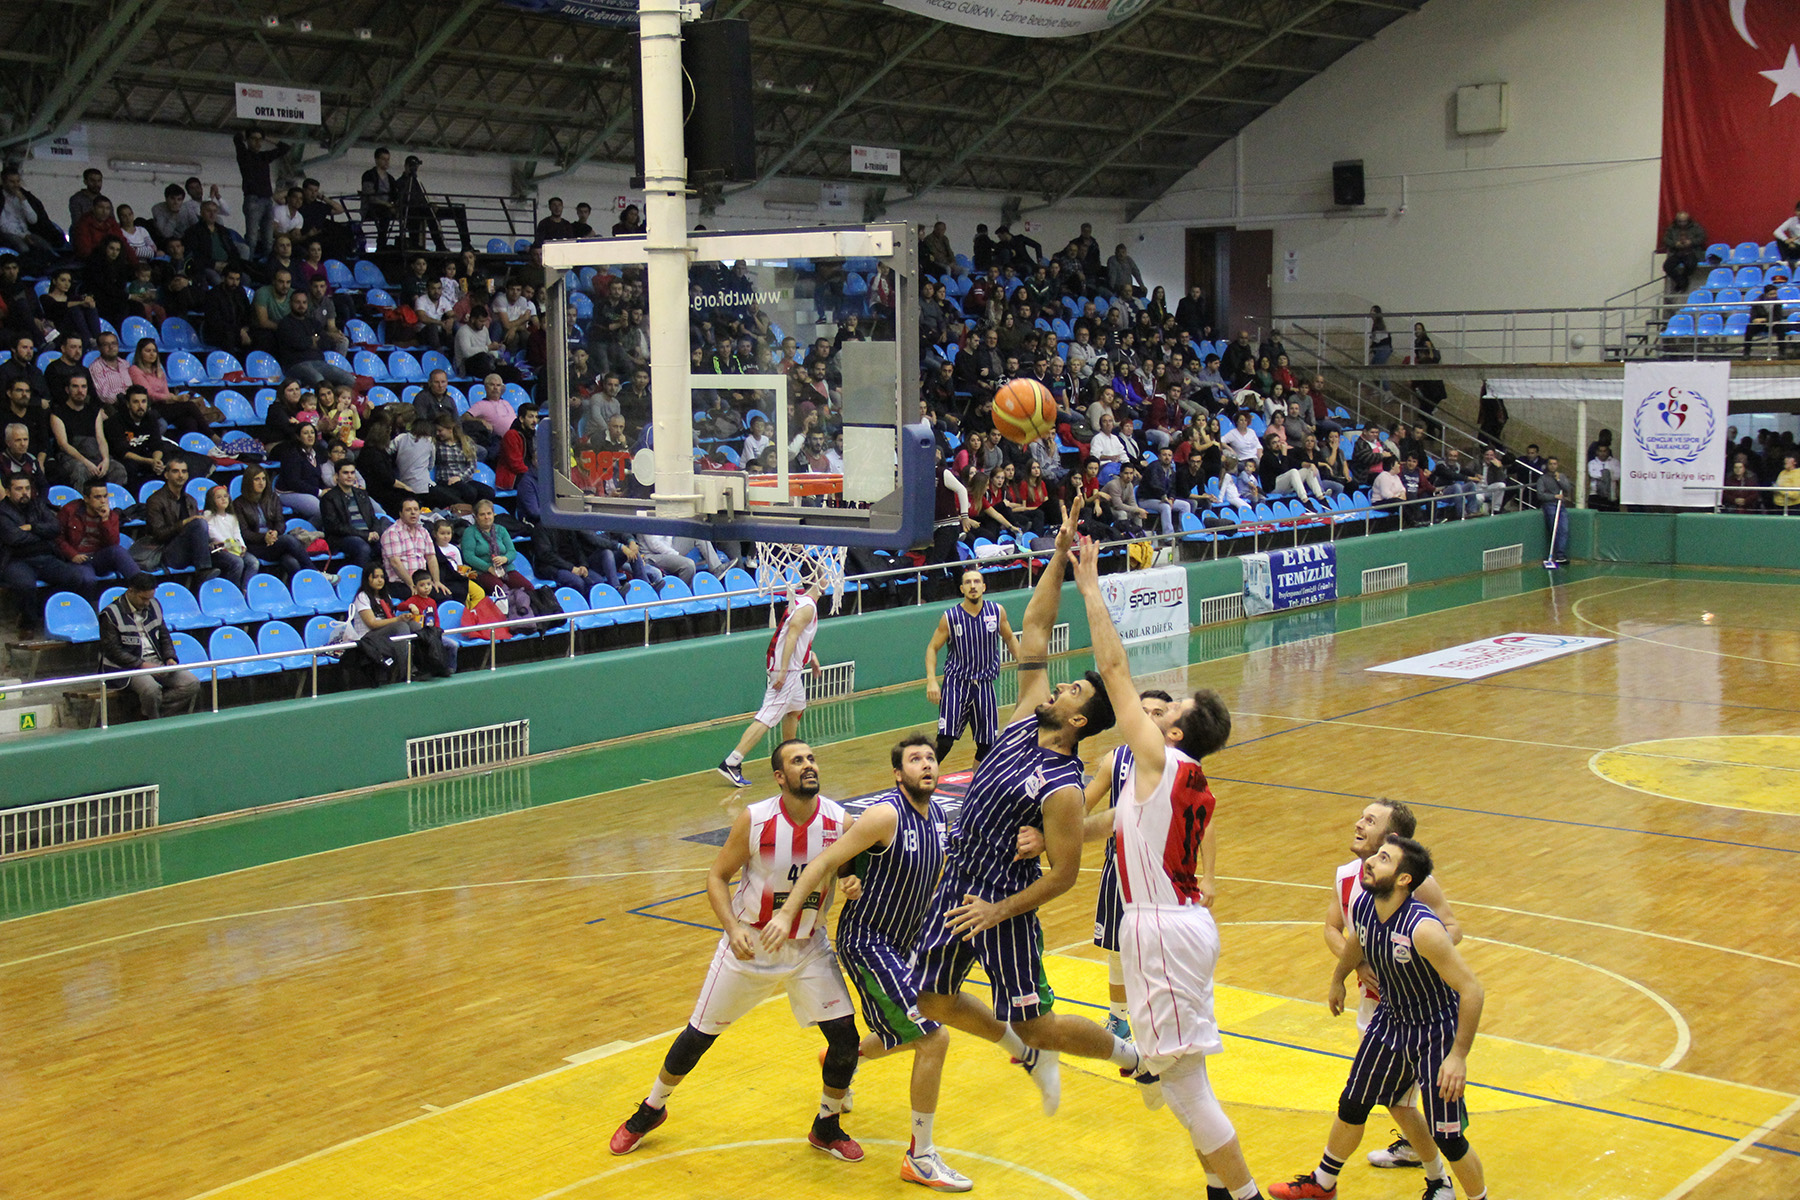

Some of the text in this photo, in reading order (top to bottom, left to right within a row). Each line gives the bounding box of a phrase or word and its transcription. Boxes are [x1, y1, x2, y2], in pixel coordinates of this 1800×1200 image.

[255, 106, 275, 117] ORTA
[1629, 470, 1657, 480] Güçlü
[1660, 471, 1695, 481] Türkiye
[1280, 544, 1329, 567] ERK
[1277, 562, 1334, 588] TEMİZLİK
[22, 715, 35, 729] A
